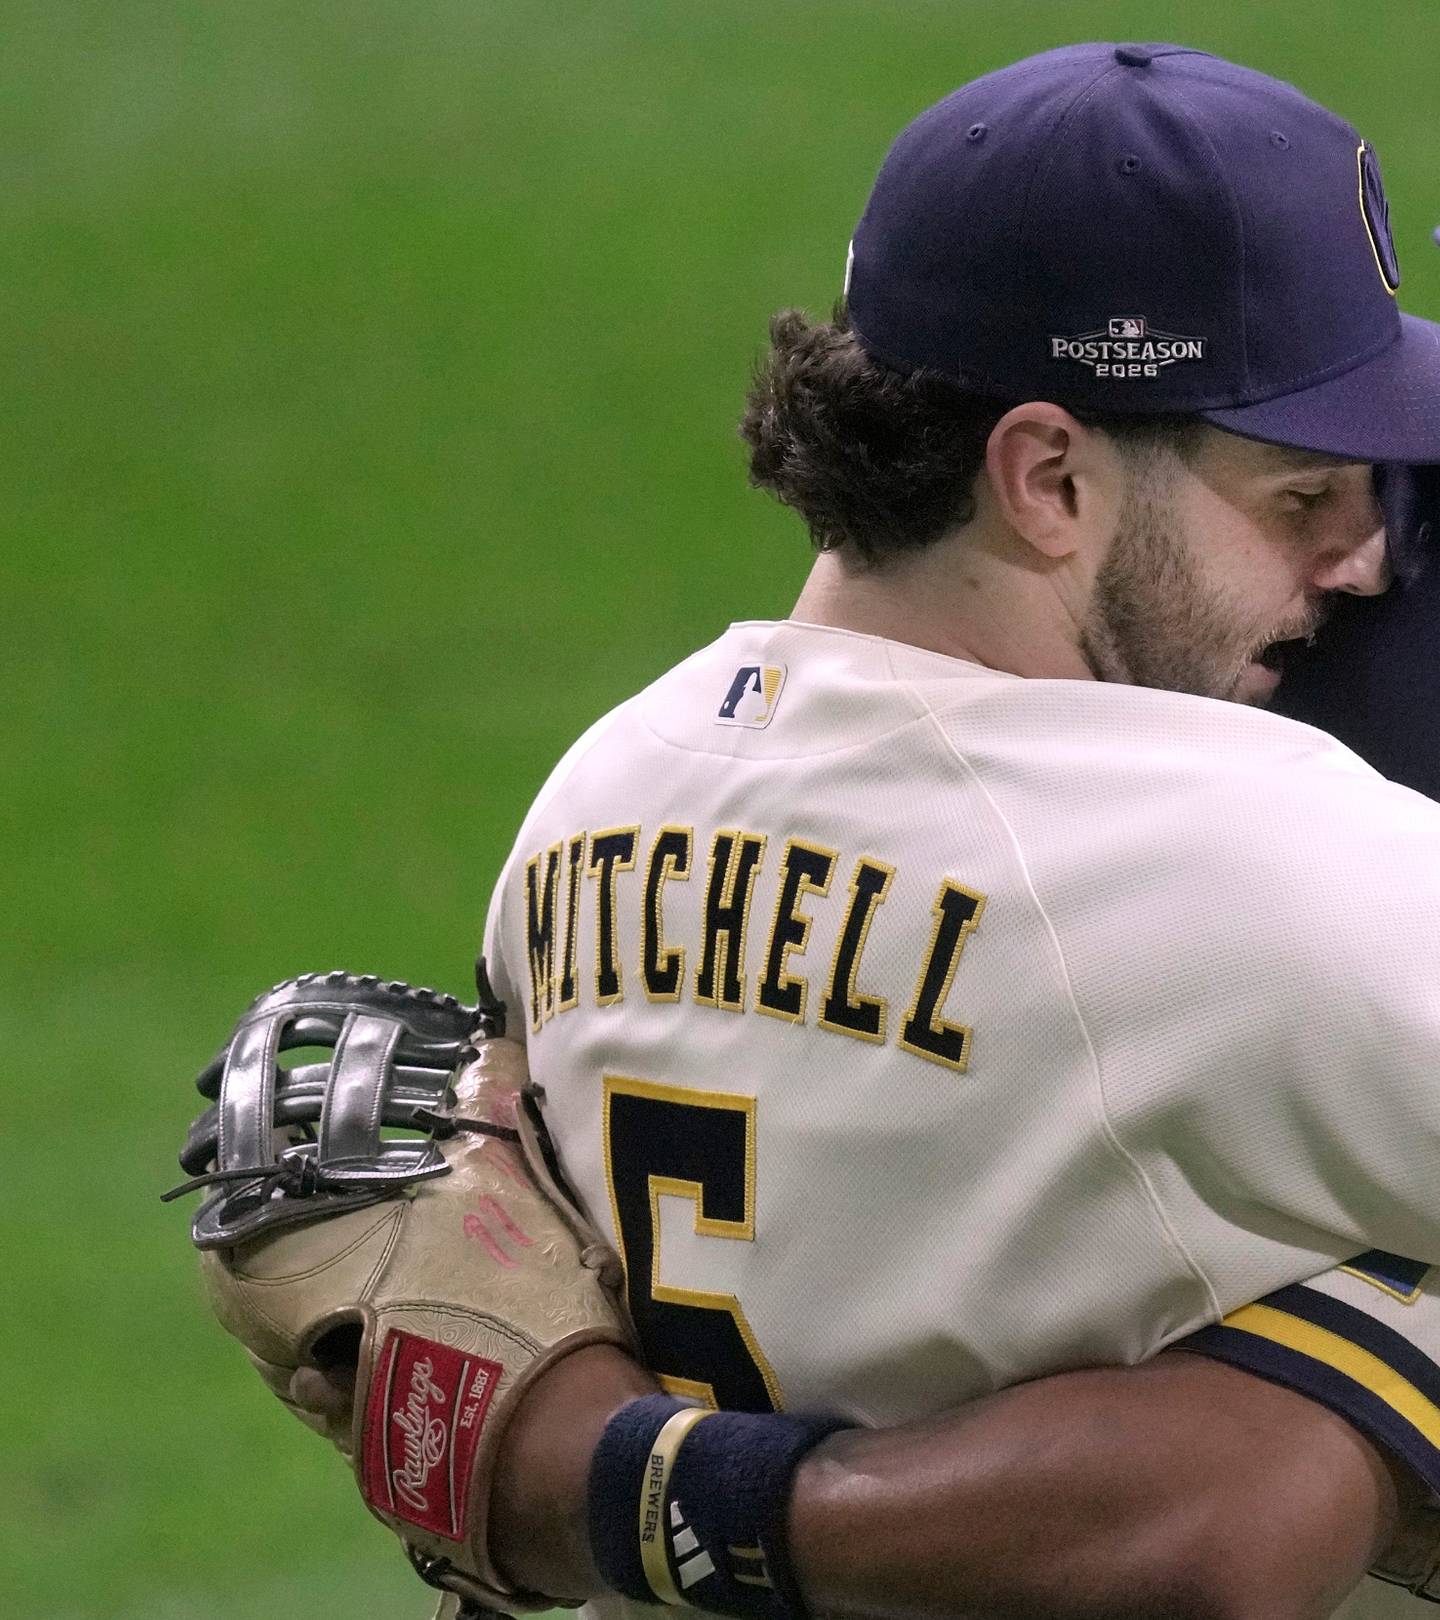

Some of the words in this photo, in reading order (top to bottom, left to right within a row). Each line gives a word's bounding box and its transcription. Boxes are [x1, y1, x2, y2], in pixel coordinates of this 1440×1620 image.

[1051, 338, 1203, 360] POSTSEASON
[1095, 363, 1158, 378] 2026
[524, 824, 987, 1074] MITCHELL
[468, 1367, 490, 1400] 1887
[460, 1401, 480, 1430] Est.
[392, 1356, 446, 1512] Rawlings
[641, 1453, 665, 1544] BREWERS
